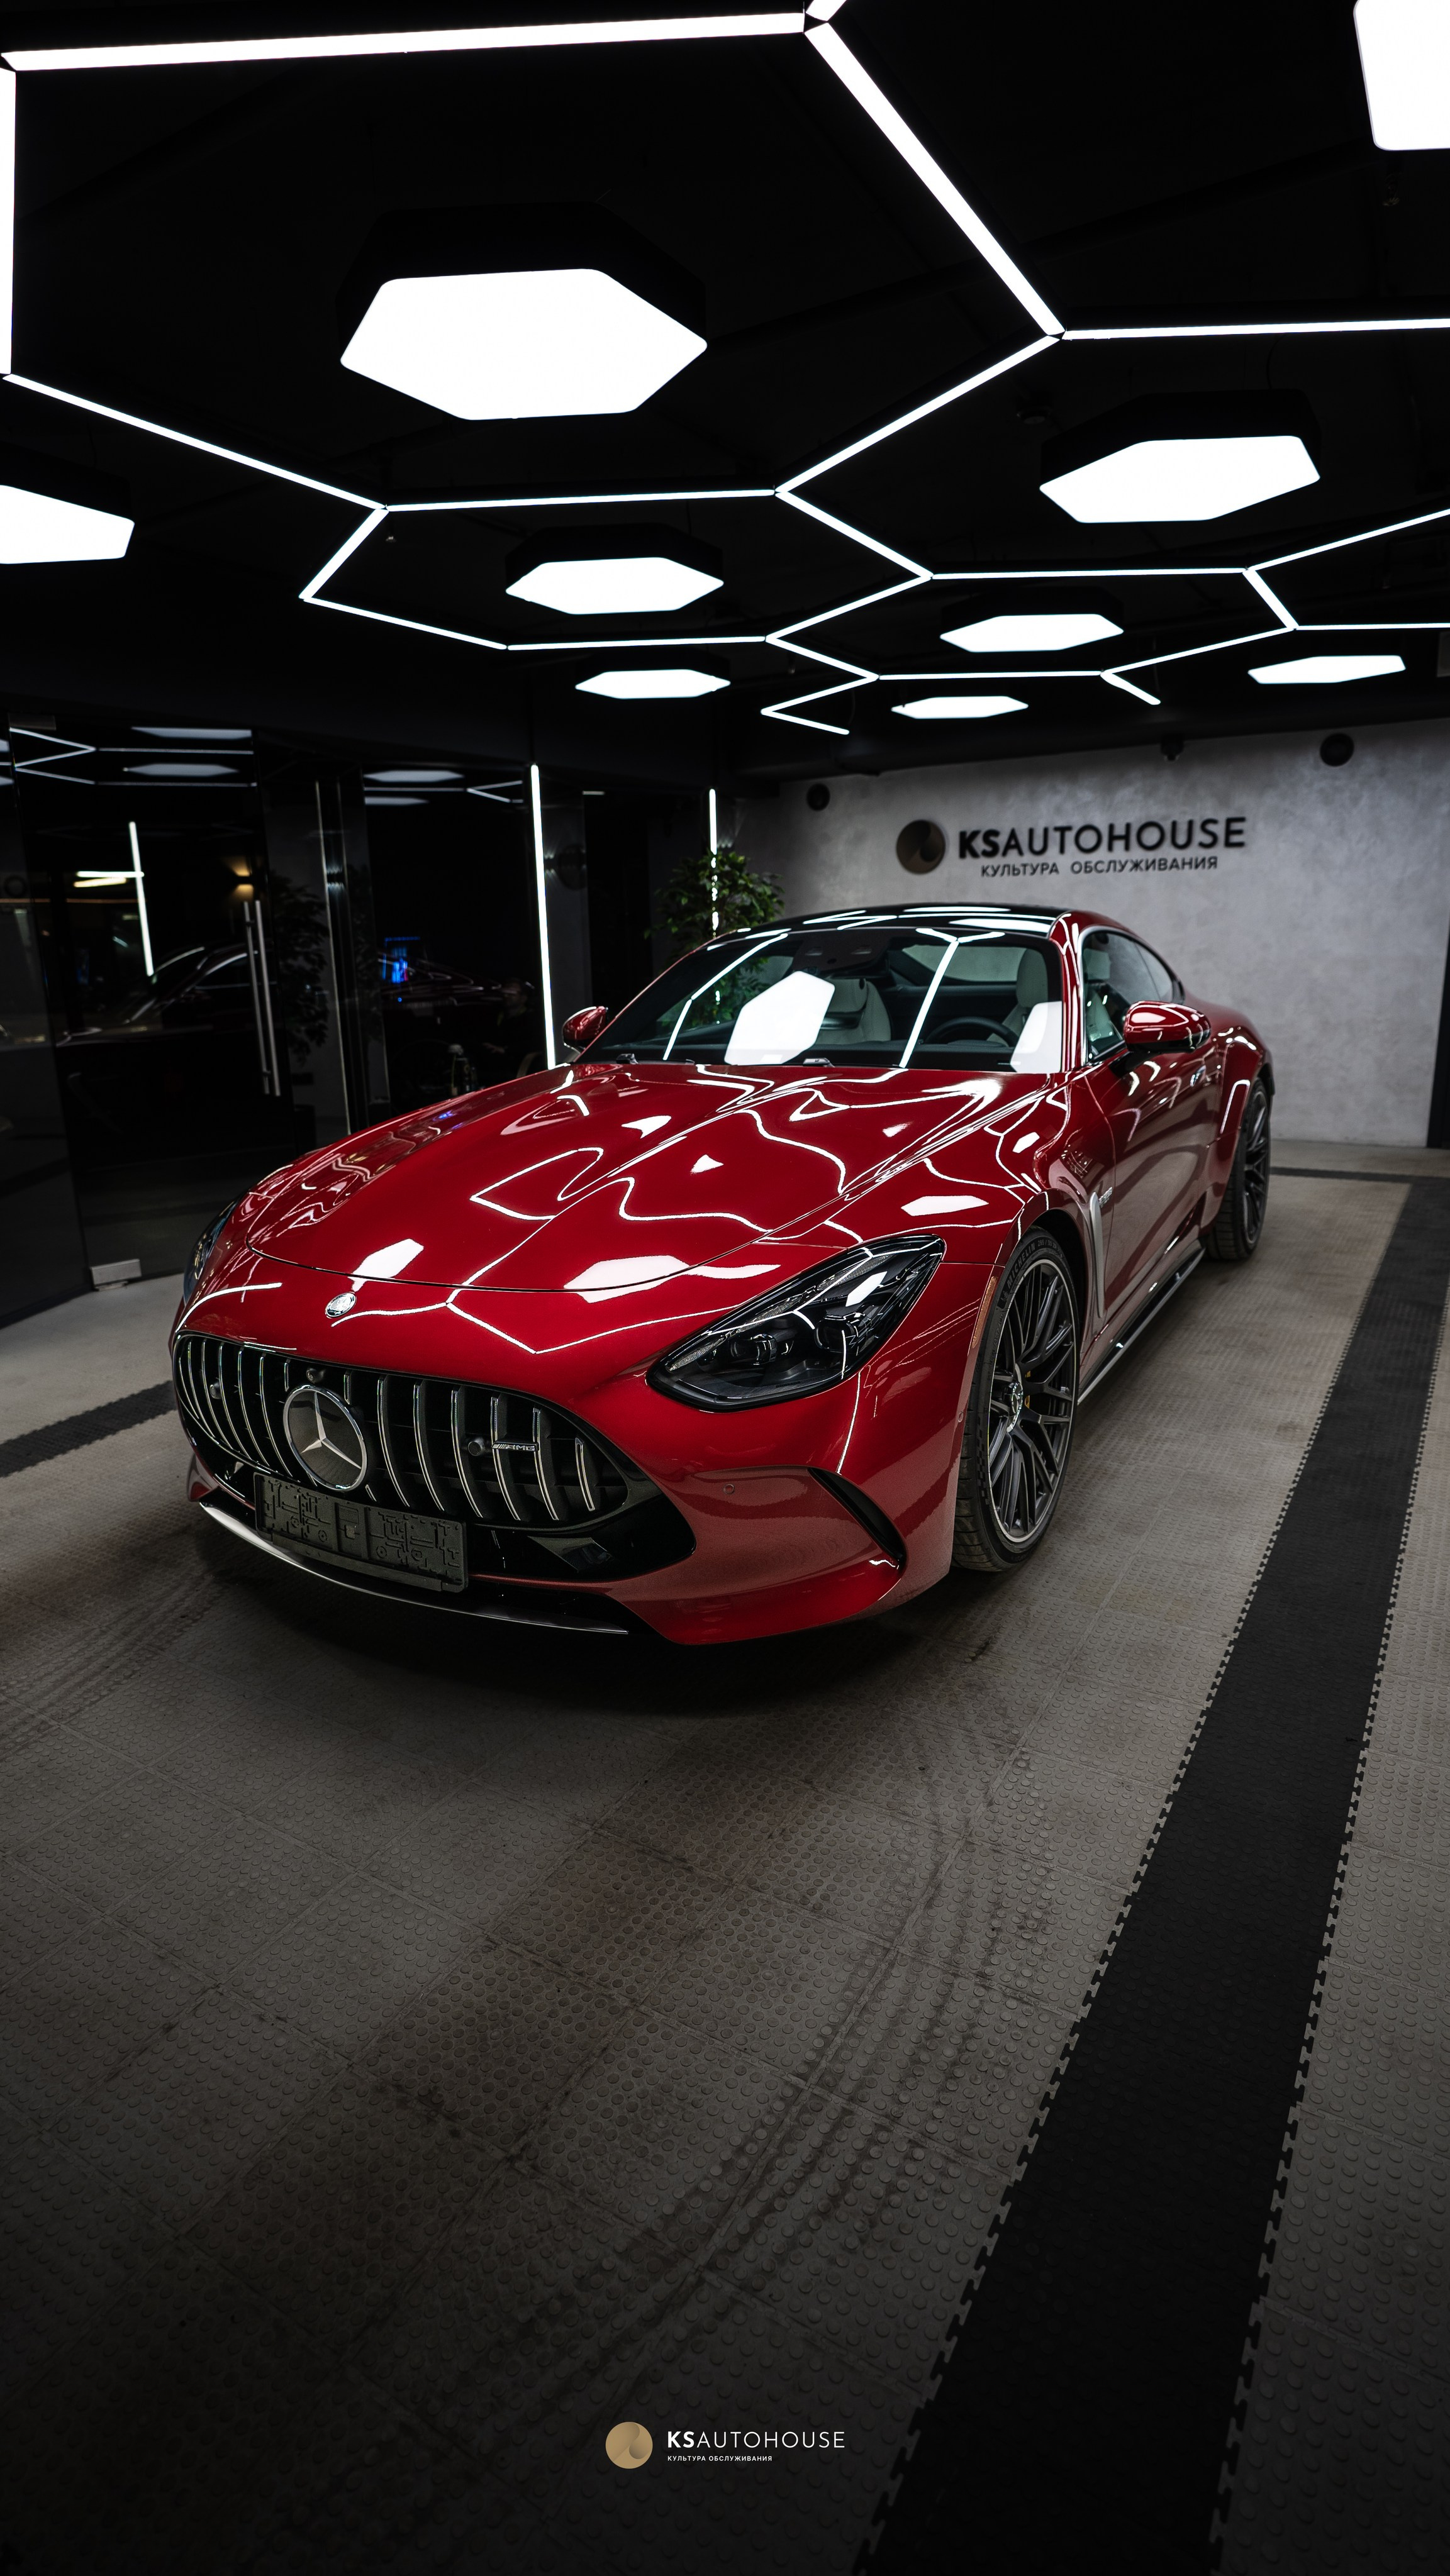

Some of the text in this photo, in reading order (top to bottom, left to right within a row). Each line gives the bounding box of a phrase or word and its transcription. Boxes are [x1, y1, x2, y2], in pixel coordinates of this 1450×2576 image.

[959, 817, 1246, 858] KSAUTOHOUSE
[981, 856, 1219, 877] КУЛЬТУРА ОБСЛУЖИВАНИЯ
[1007, 1242, 1035, 1289] MICHELIN
